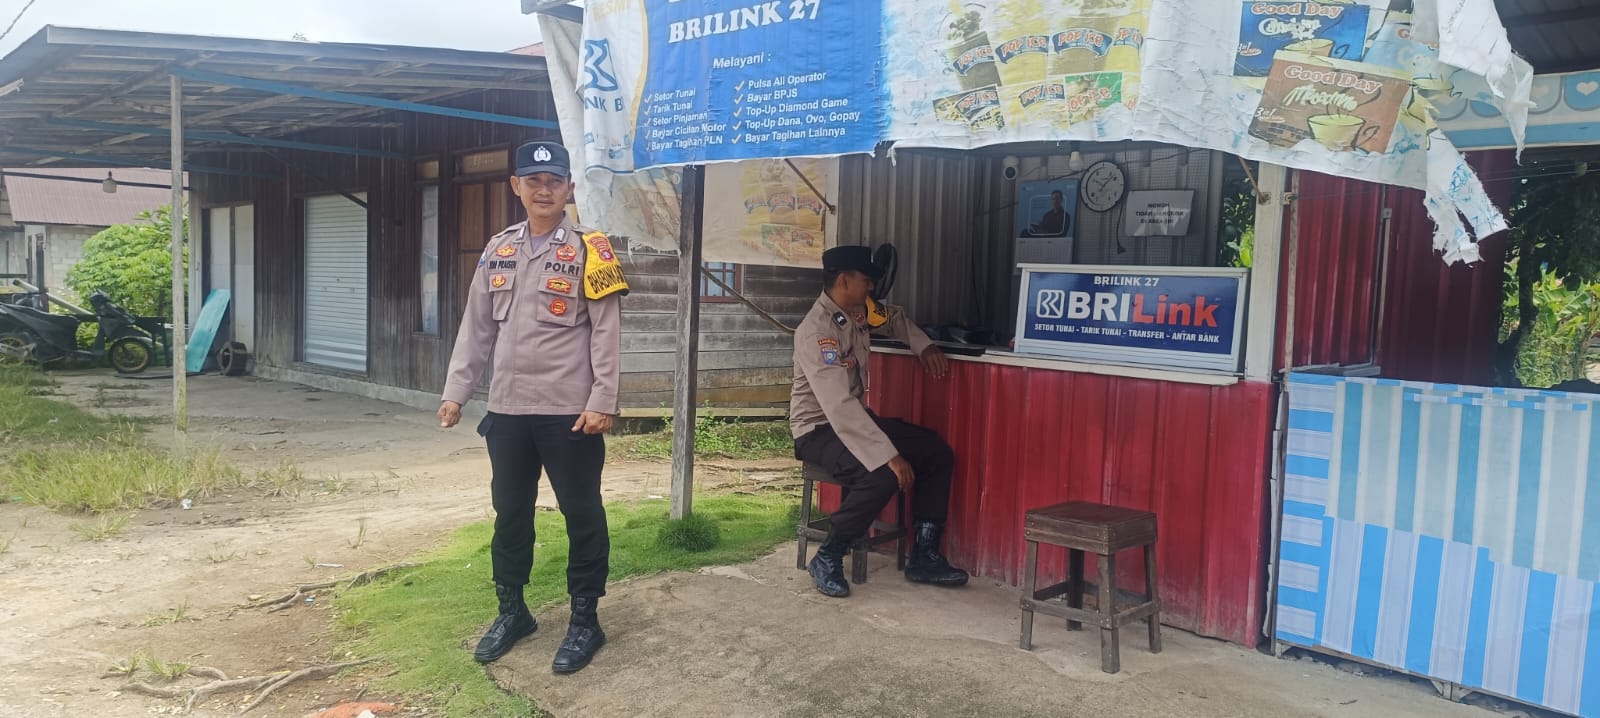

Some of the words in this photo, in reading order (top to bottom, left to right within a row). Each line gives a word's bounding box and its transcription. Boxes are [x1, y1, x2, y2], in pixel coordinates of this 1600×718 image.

[1250, 2, 1301, 16] Good
[1303, 3, 1344, 19] Day
[668, 1, 783, 43] BRILINK
[789, 0, 821, 20] 27
[1057, 30, 1081, 47] POP
[1001, 38, 1024, 58] POP
[713, 52, 764, 69] Melayani
[957, 52, 973, 70] POP
[748, 78, 771, 89] Pulsa
[773, 76, 786, 86] All
[787, 72, 826, 84] Operator
[1284, 65, 1336, 85] Good
[1337, 72, 1383, 94] Day
[654, 92, 673, 102] Setor
[675, 88, 696, 98] Tunai
[747, 93, 773, 103] Bayar
[774, 88, 798, 100] BPJS
[959, 95, 976, 112] POP
[1021, 87, 1041, 104] POP
[1068, 95, 1087, 112] OP
[653, 104, 671, 113] Tarik
[673, 100, 693, 111] Tunai
[746, 105, 777, 117] Top-Up
[778, 100, 819, 112] Diamond
[821, 97, 849, 108] Game
[653, 117, 672, 126] Setor
[673, 111, 708, 123] Pinjaman
[745, 119, 776, 131] Top-Up
[778, 117, 803, 127] Dana,
[805, 114, 827, 124] Ovo,
[829, 111, 861, 123] Gopay
[652, 129, 673, 140] Bayar
[675, 126, 700, 135] Cicilan
[701, 122, 727, 134] Motor
[745, 132, 770, 144] Bayar
[772, 130, 806, 141] Tagihan
[808, 126, 846, 138] Lainnya
[651, 142, 673, 152] Bayar
[675, 138, 703, 149] Tagihan
[704, 134, 723, 144] PLN
[544, 261, 580, 276] POLRI
[1094, 275, 1141, 287] BRILINK
[1144, 277, 1160, 287] 27
[1067, 290, 1220, 328] BRILink
[1034, 323, 1054, 331] SETOR
[1056, 325, 1075, 333] TUNAI
[1081, 326, 1100, 335] TARIK
[1101, 328, 1122, 337] TUNAI
[1128, 330, 1165, 339] TRANSFER
[1171, 333, 1196, 342] ANTAR
[1198, 335, 1220, 343] BANK
